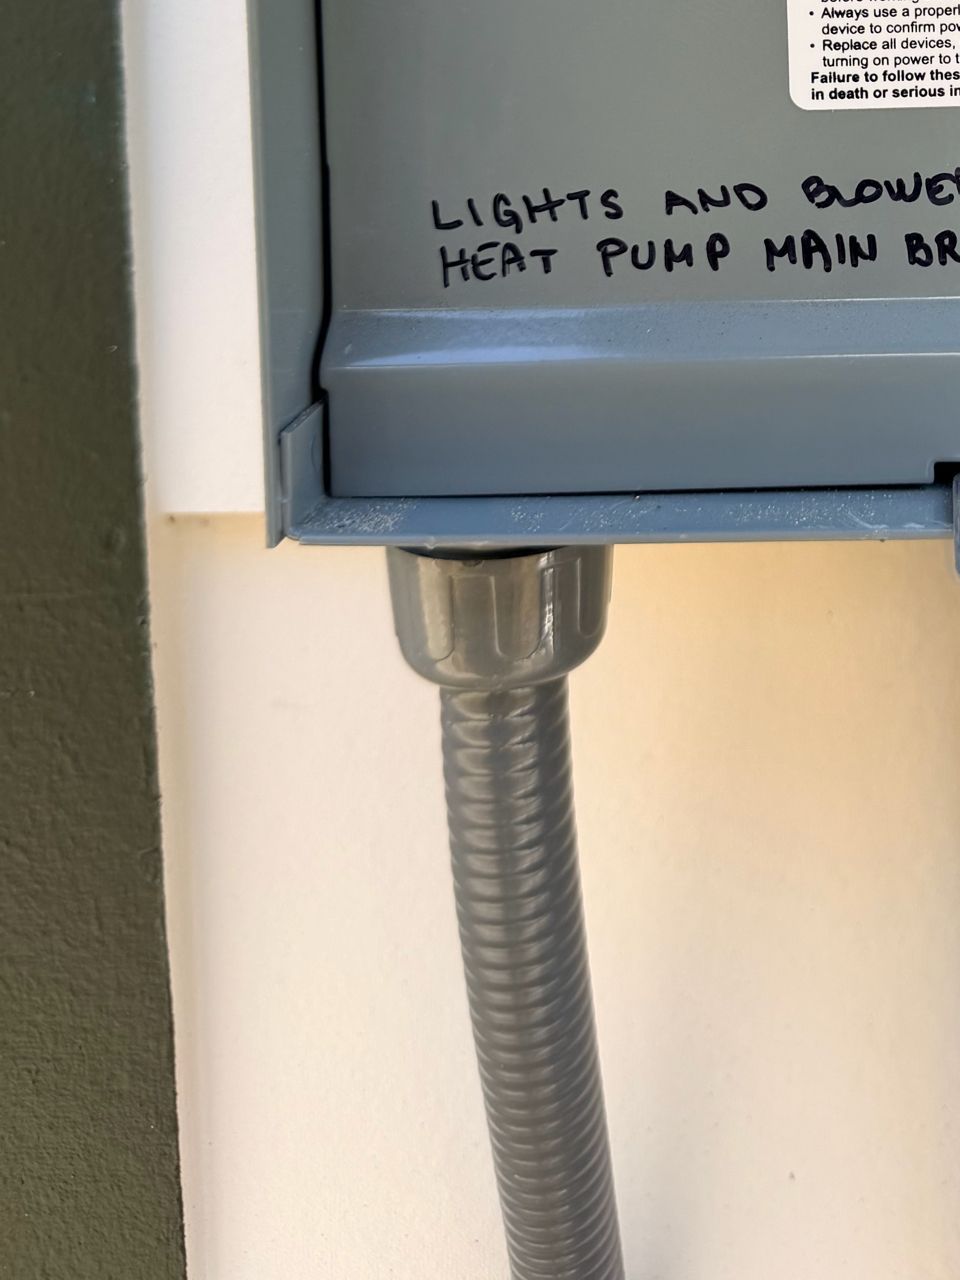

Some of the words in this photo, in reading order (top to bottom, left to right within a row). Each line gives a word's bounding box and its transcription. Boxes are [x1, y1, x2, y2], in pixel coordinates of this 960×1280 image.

[811, 71, 860, 84] Failure
[864, 71, 878, 82] to
[882, 70, 926, 82] follow
[811, 88, 824, 100] in
[829, 87, 868, 100] death
[873, 89, 888, 98] or
[892, 85, 945, 98] serious
[431, 187, 624, 234] LIGHTS
[666, 181, 768, 215] AND
[438, 241, 559, 289] HEAT
[597, 233, 732, 277] PUMP
[764, 232, 879, 273] MAIN
